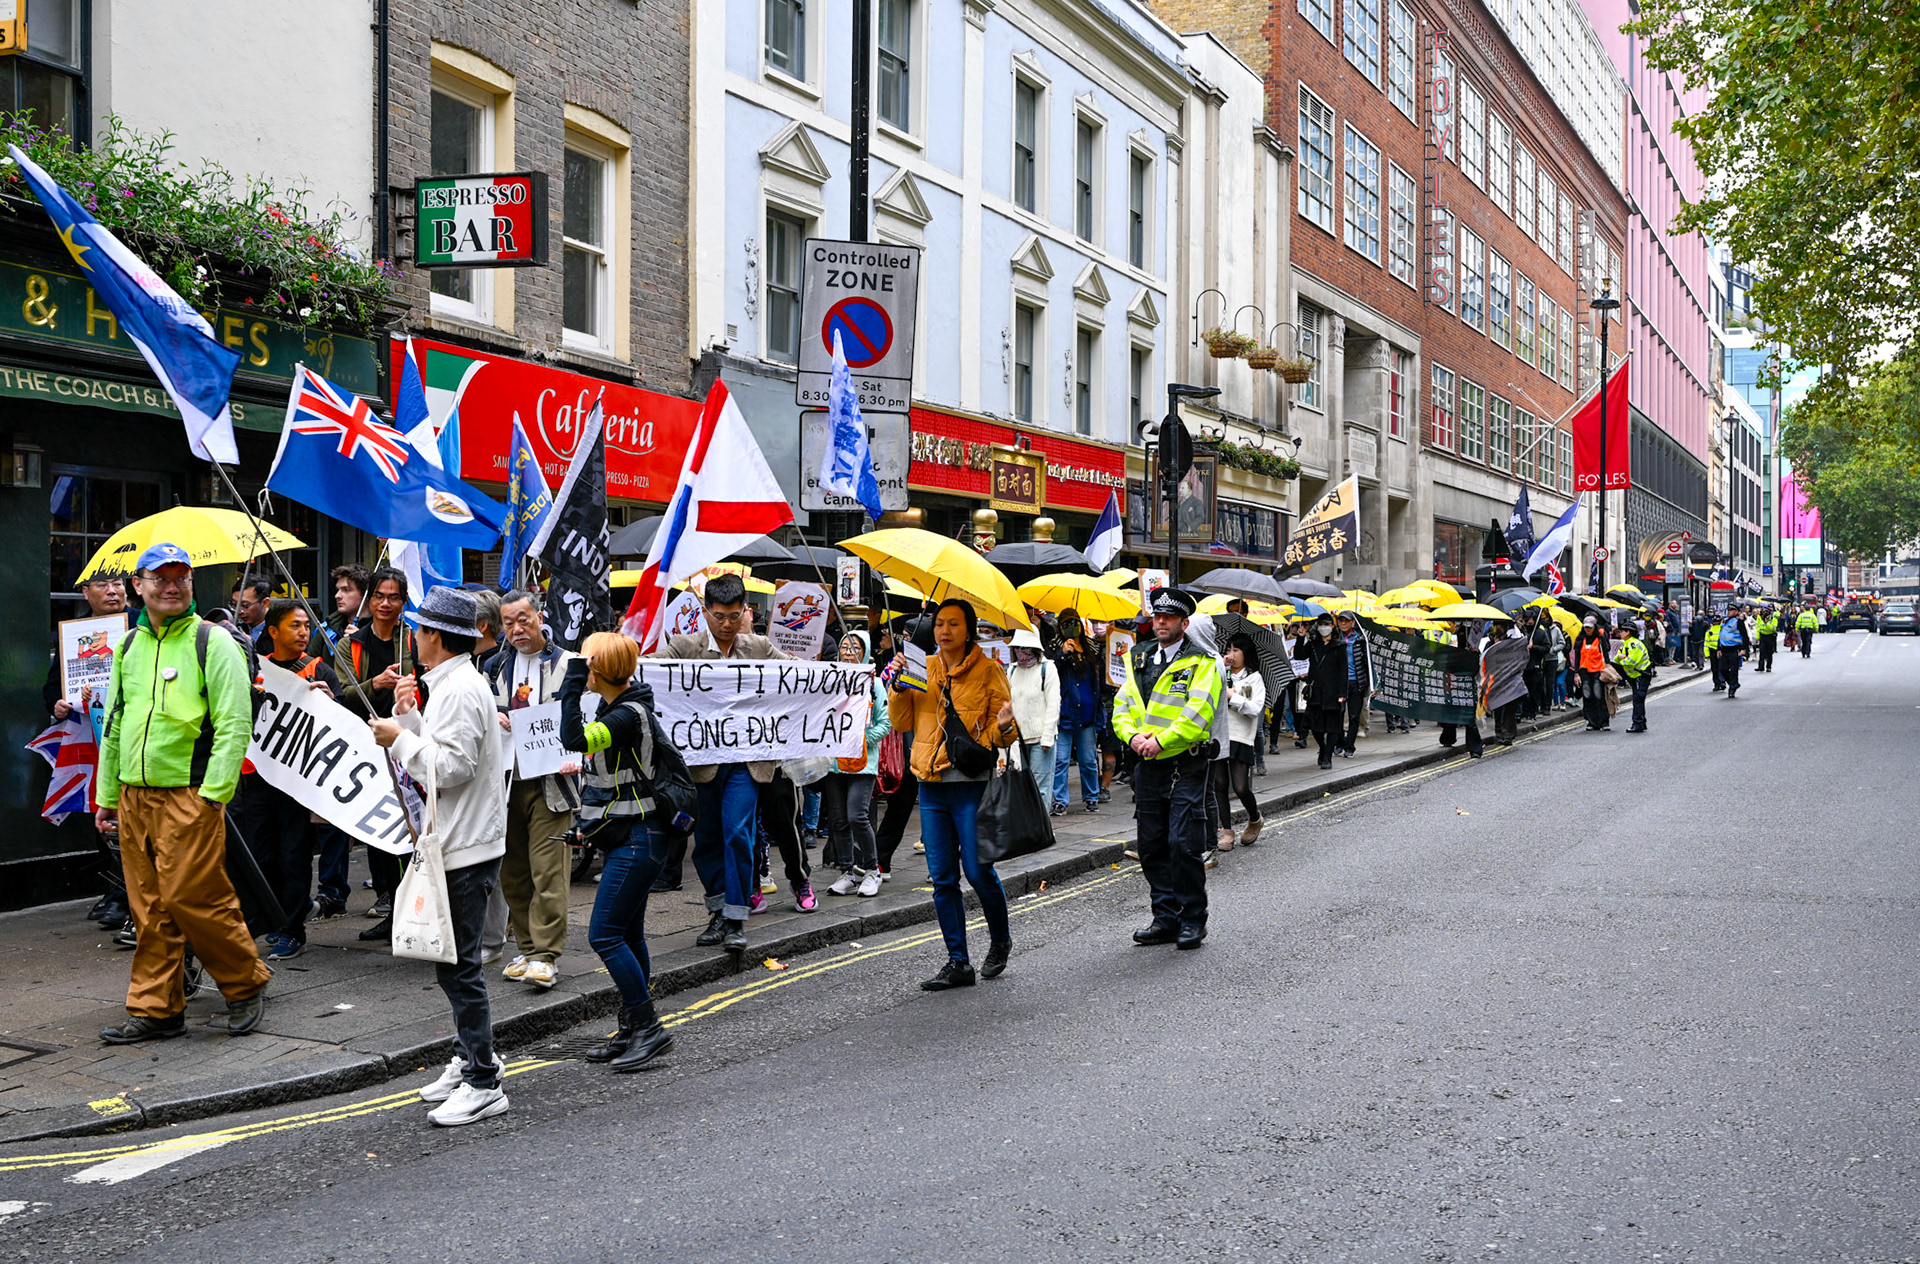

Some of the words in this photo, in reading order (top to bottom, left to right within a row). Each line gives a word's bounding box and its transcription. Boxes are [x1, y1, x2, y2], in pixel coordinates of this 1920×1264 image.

[1431, 29, 1450, 305] FOYLES
[422, 182, 527, 209] ESPRESSO
[431, 216, 518, 255] BAR
[813, 247, 911, 270] Controlled
[826, 269, 895, 293] ZONE
[22, 275, 59, 329] &
[1, 368, 50, 393] THE
[54, 375, 140, 404] COACH
[143, 388, 159, 407] &
[802, 390, 830, 402] 8.30
[858, 393, 886, 405] 6.30
[888, 398, 905, 408] pm
[862, 381, 882, 392] Sat
[544, 462, 558, 476] HOT
[606, 470, 628, 486] PRESSO
[633, 475, 650, 489] PIZZA
[524, 738, 547, 751] STAY
